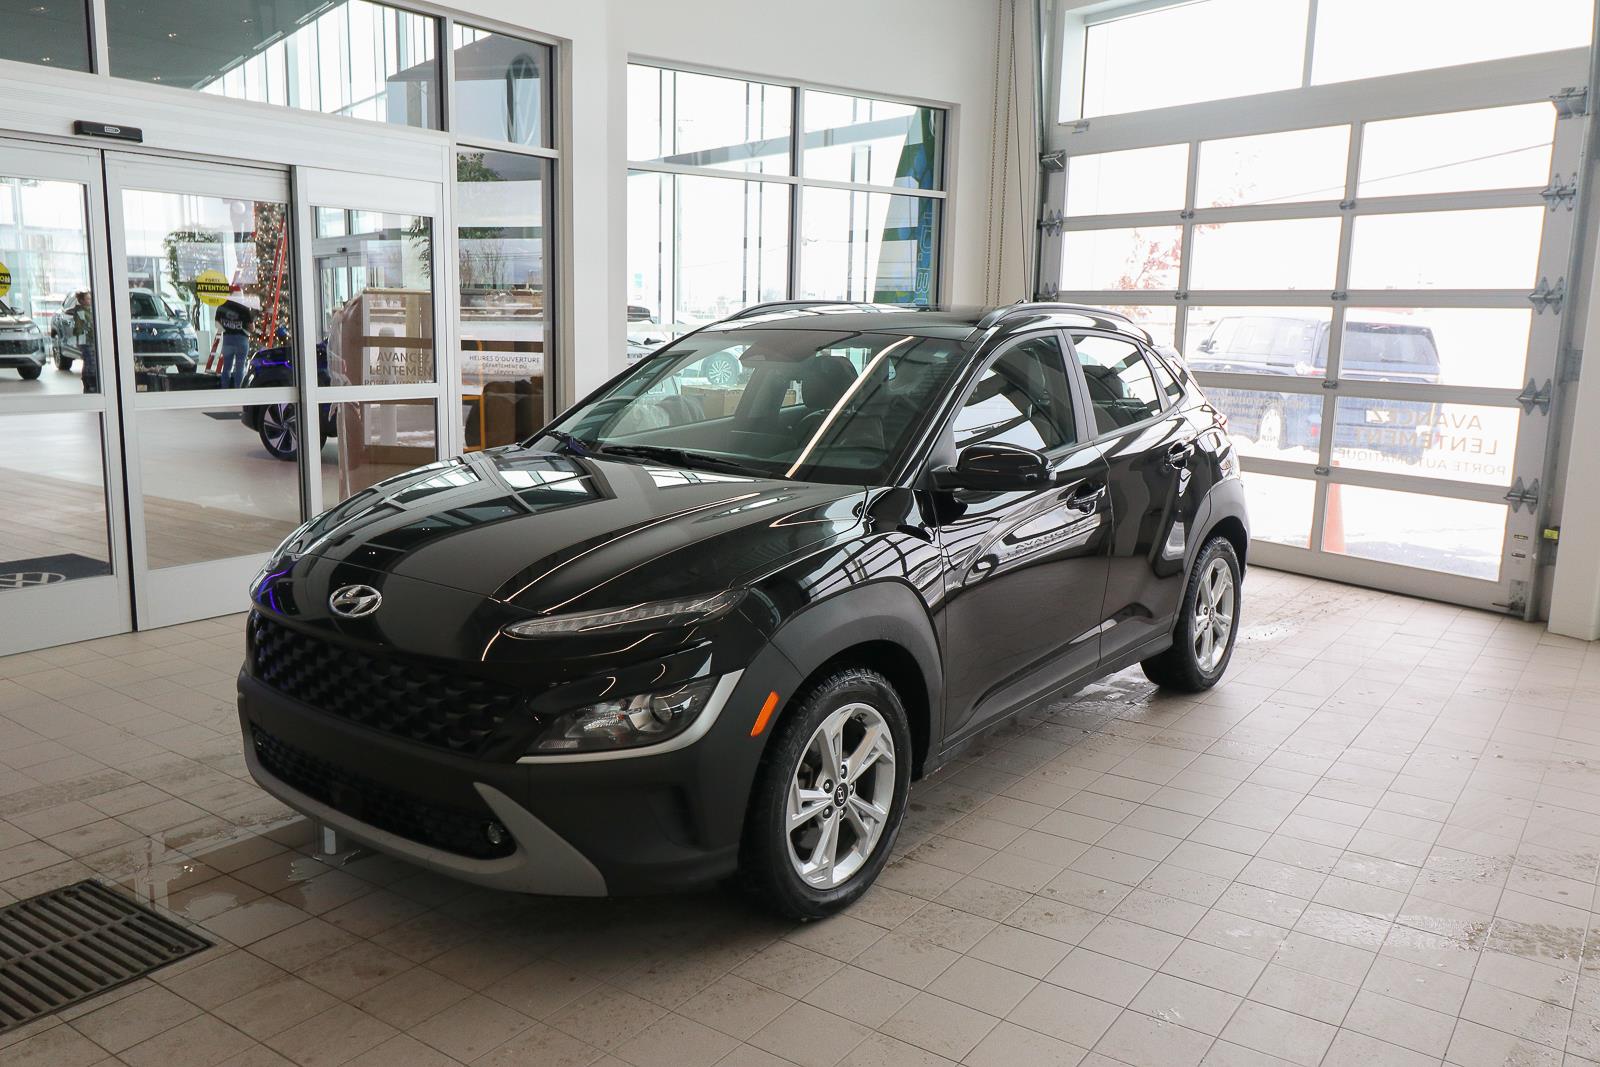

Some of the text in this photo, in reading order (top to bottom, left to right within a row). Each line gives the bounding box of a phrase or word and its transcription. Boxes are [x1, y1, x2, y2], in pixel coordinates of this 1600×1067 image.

[197, 284, 229, 292] ATTENTION
[377, 351, 430, 364] AVANCEZ
[369, 365, 433, 378] LENTEMEN
